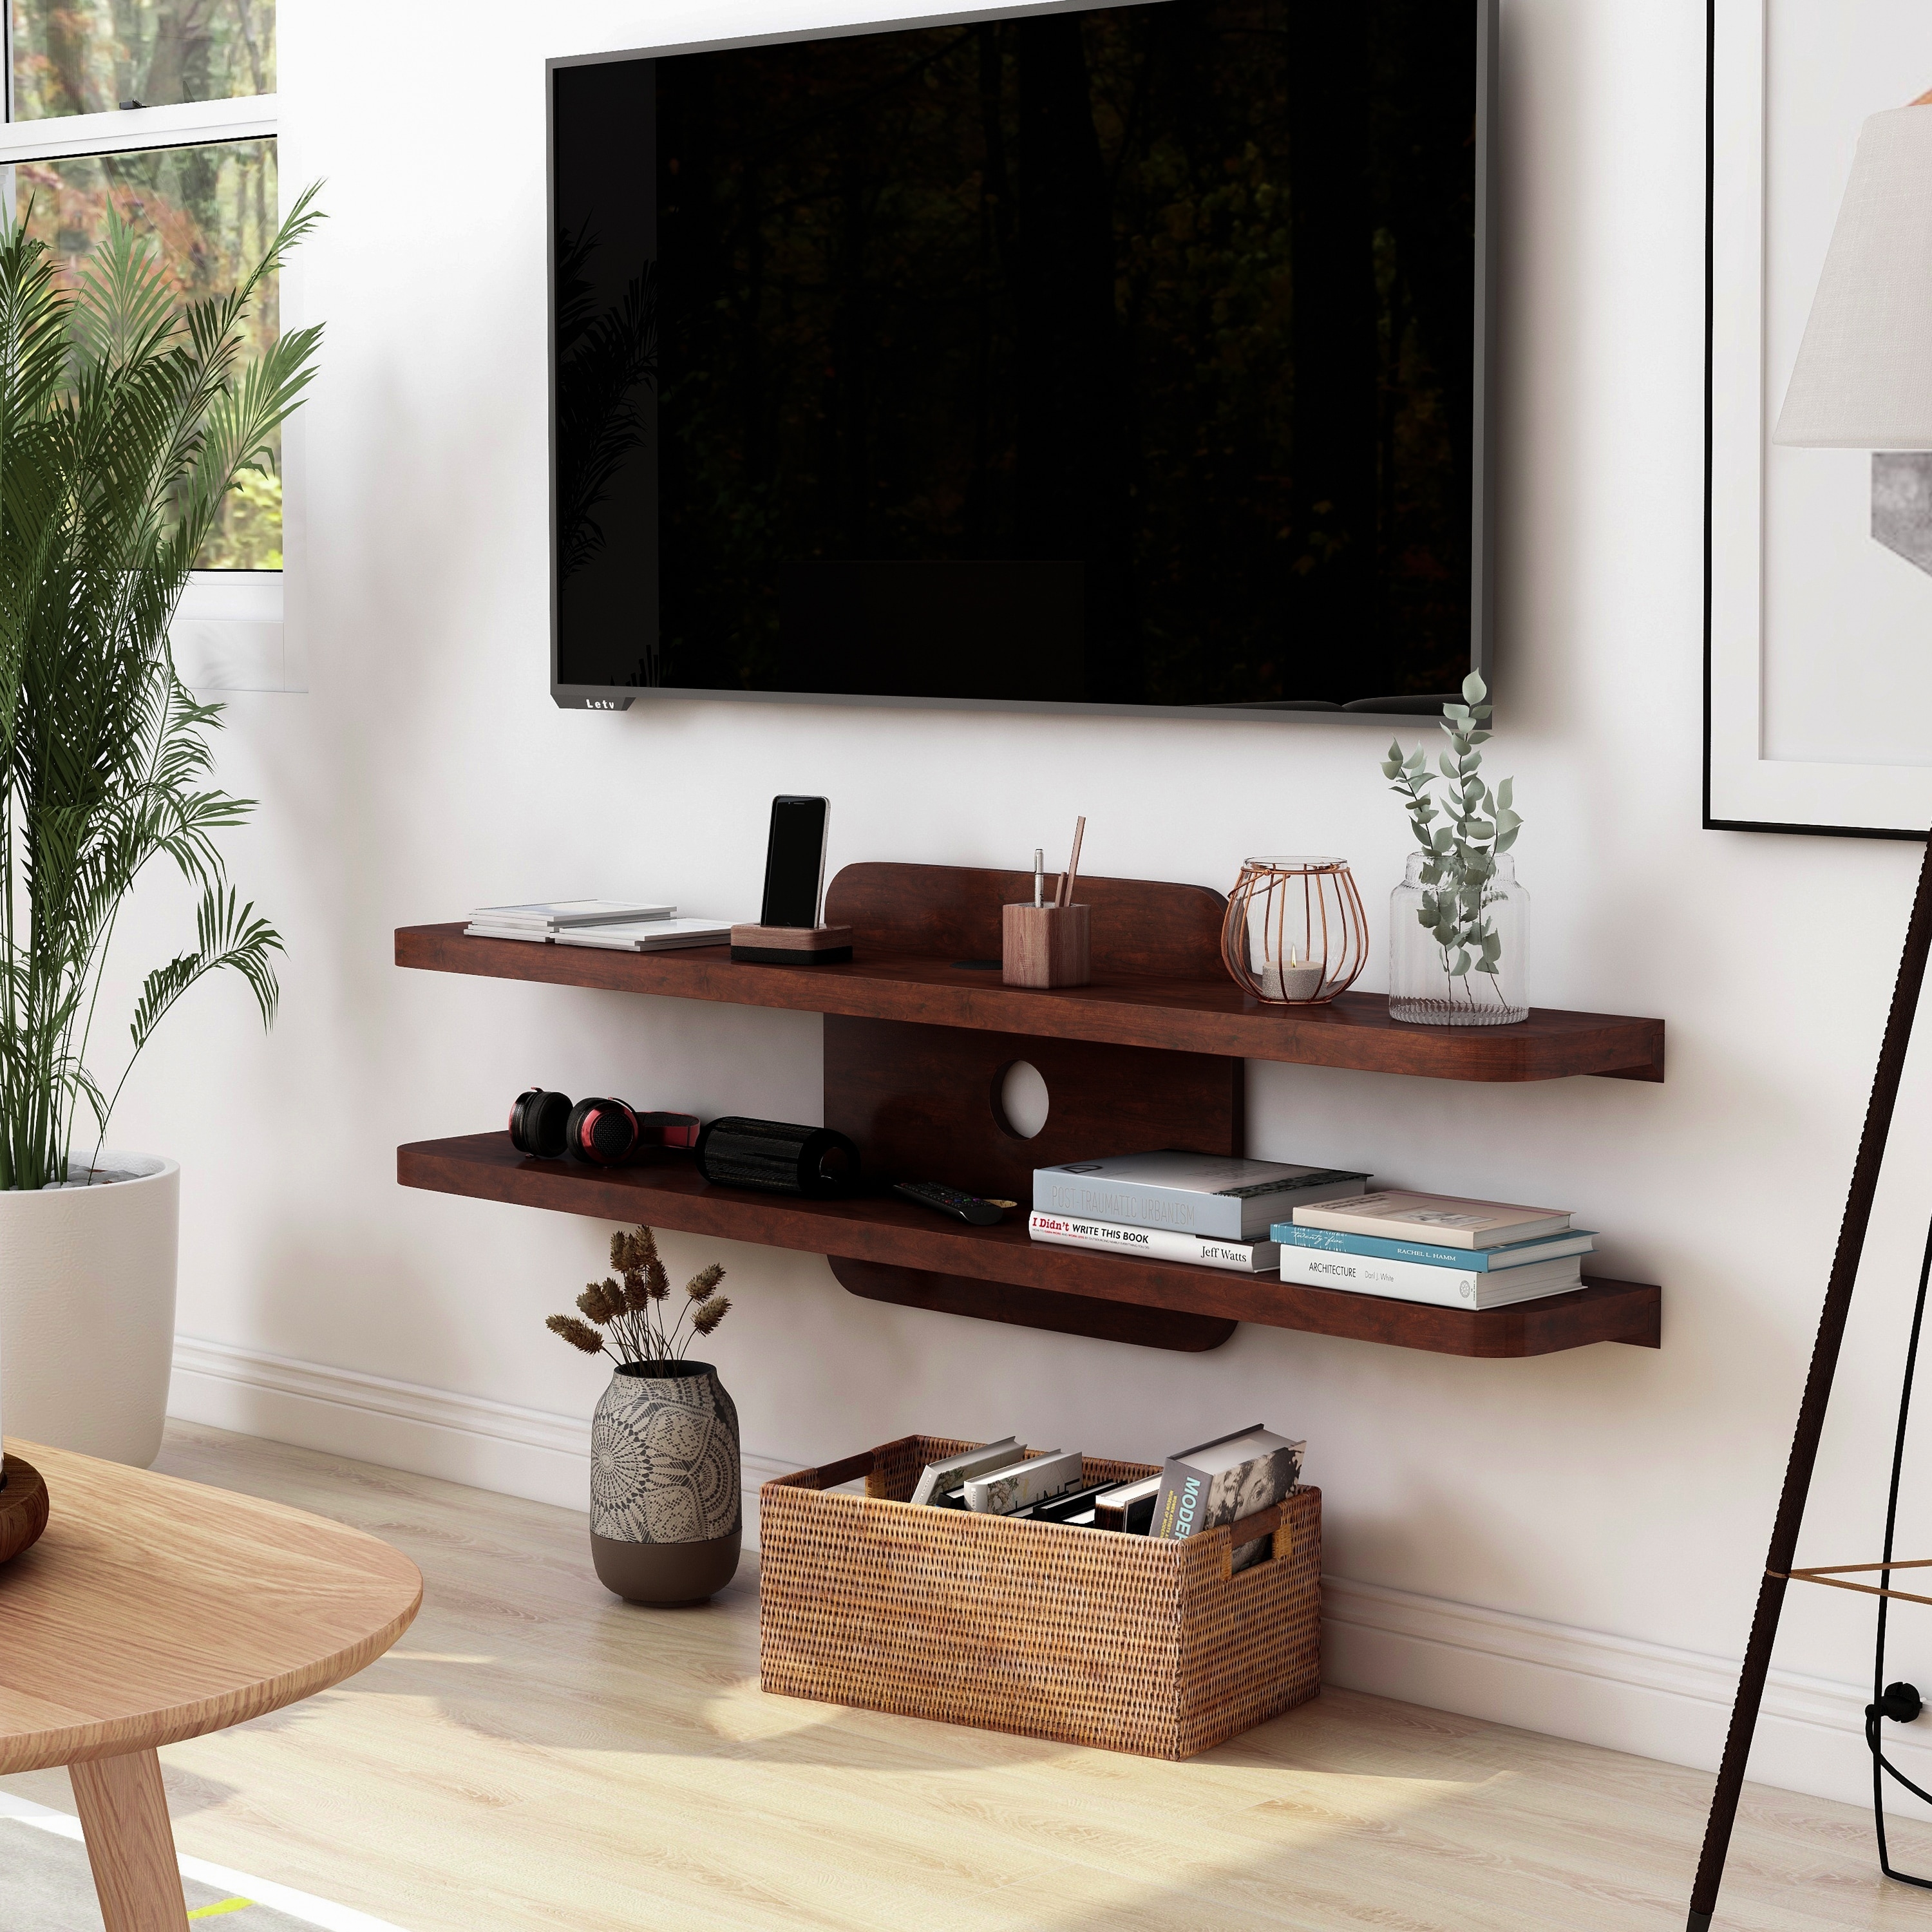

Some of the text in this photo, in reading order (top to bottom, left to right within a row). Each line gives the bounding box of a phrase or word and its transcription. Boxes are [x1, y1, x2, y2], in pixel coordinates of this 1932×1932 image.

[585, 699, 614, 709] Letv
[1052, 1186, 1195, 1226] POST-TRAUMATIC URBANISM
[1032, 1217, 1038, 1226] I
[1072, 1224, 1099, 1236] WRITE
[1101, 1228, 1121, 1239] THIS
[1122, 1231, 1150, 1244] BOOK
[1200, 1245, 1247, 1262] Jeff Watts
[1397, 1248, 1425, 1256] RACHEL
[1309, 1262, 1356, 1278] ARCHITECTURE
